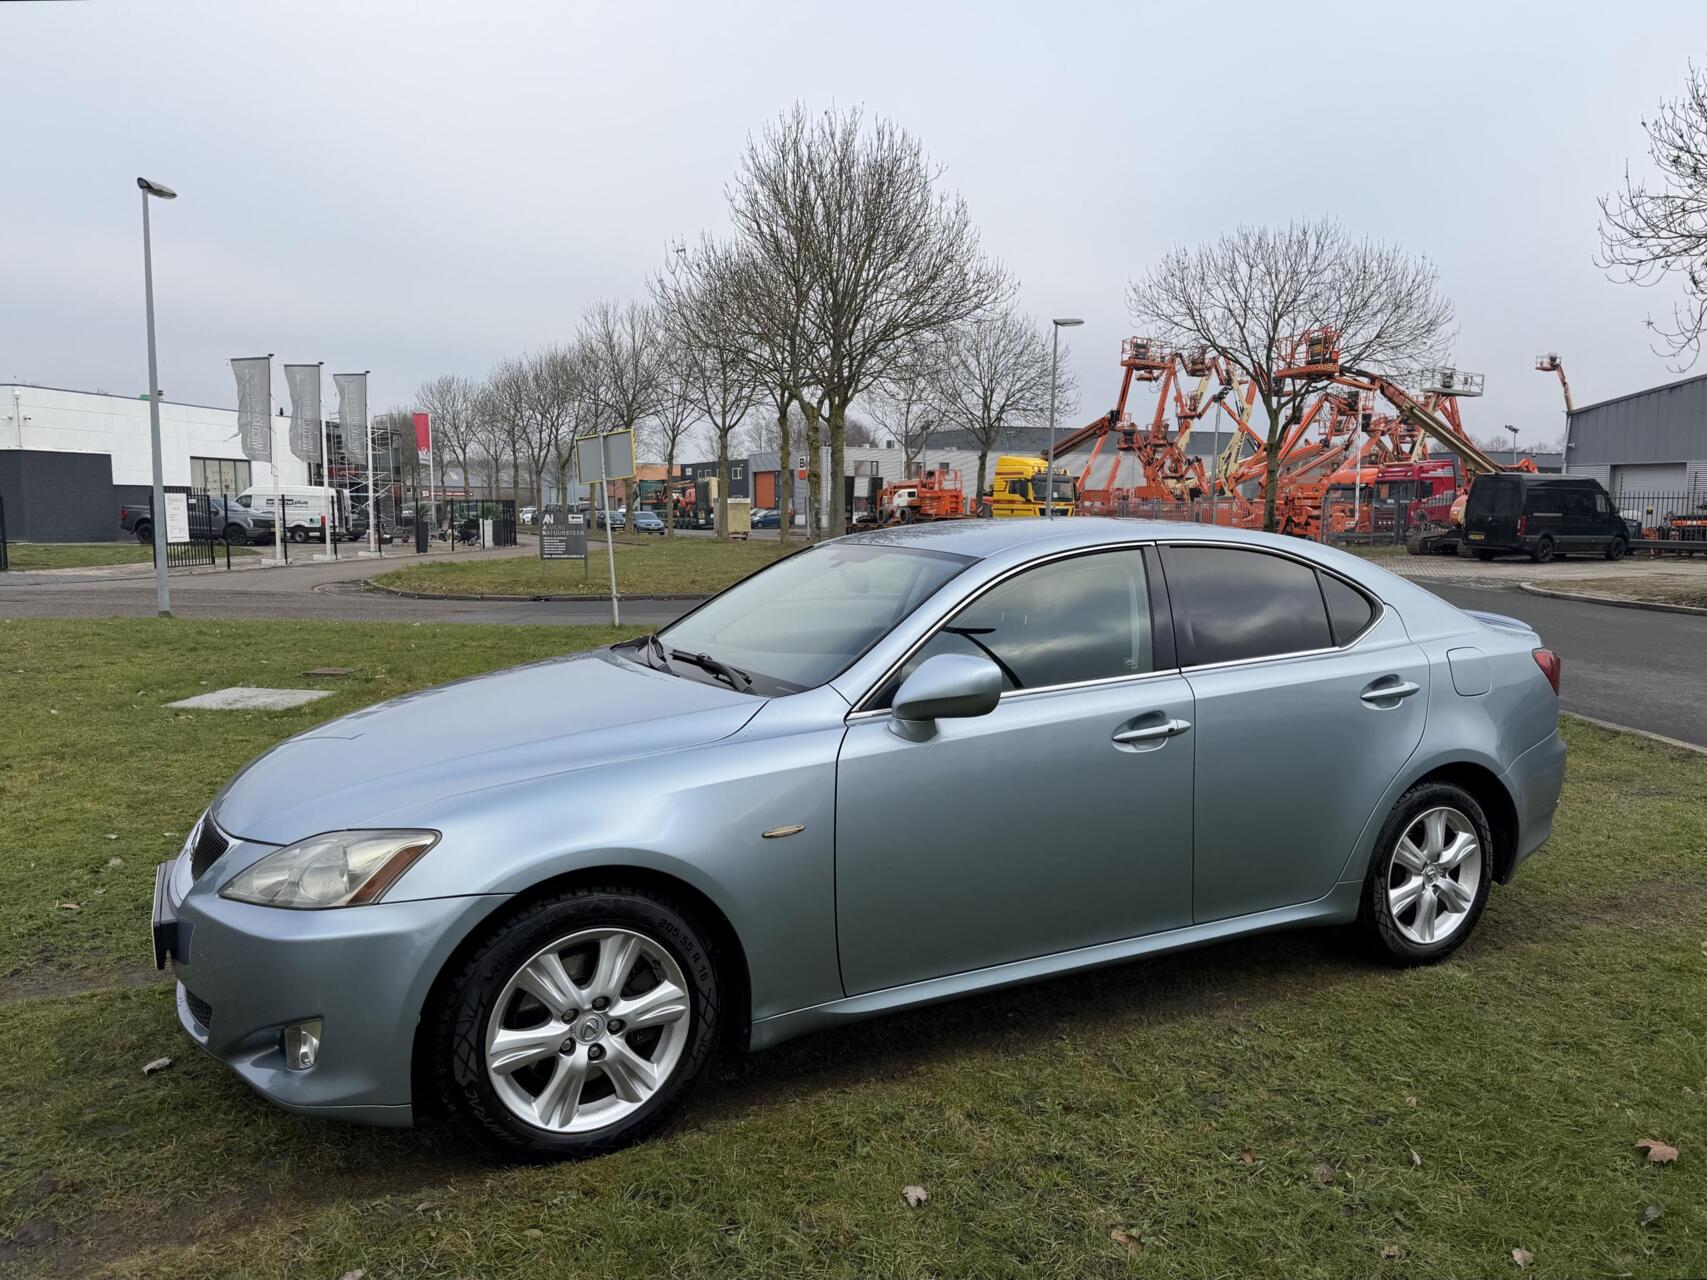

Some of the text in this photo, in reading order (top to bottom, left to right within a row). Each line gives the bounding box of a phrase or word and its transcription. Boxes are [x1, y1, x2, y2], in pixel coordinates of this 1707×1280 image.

[658, 918, 709, 982] 205/55 R 16
